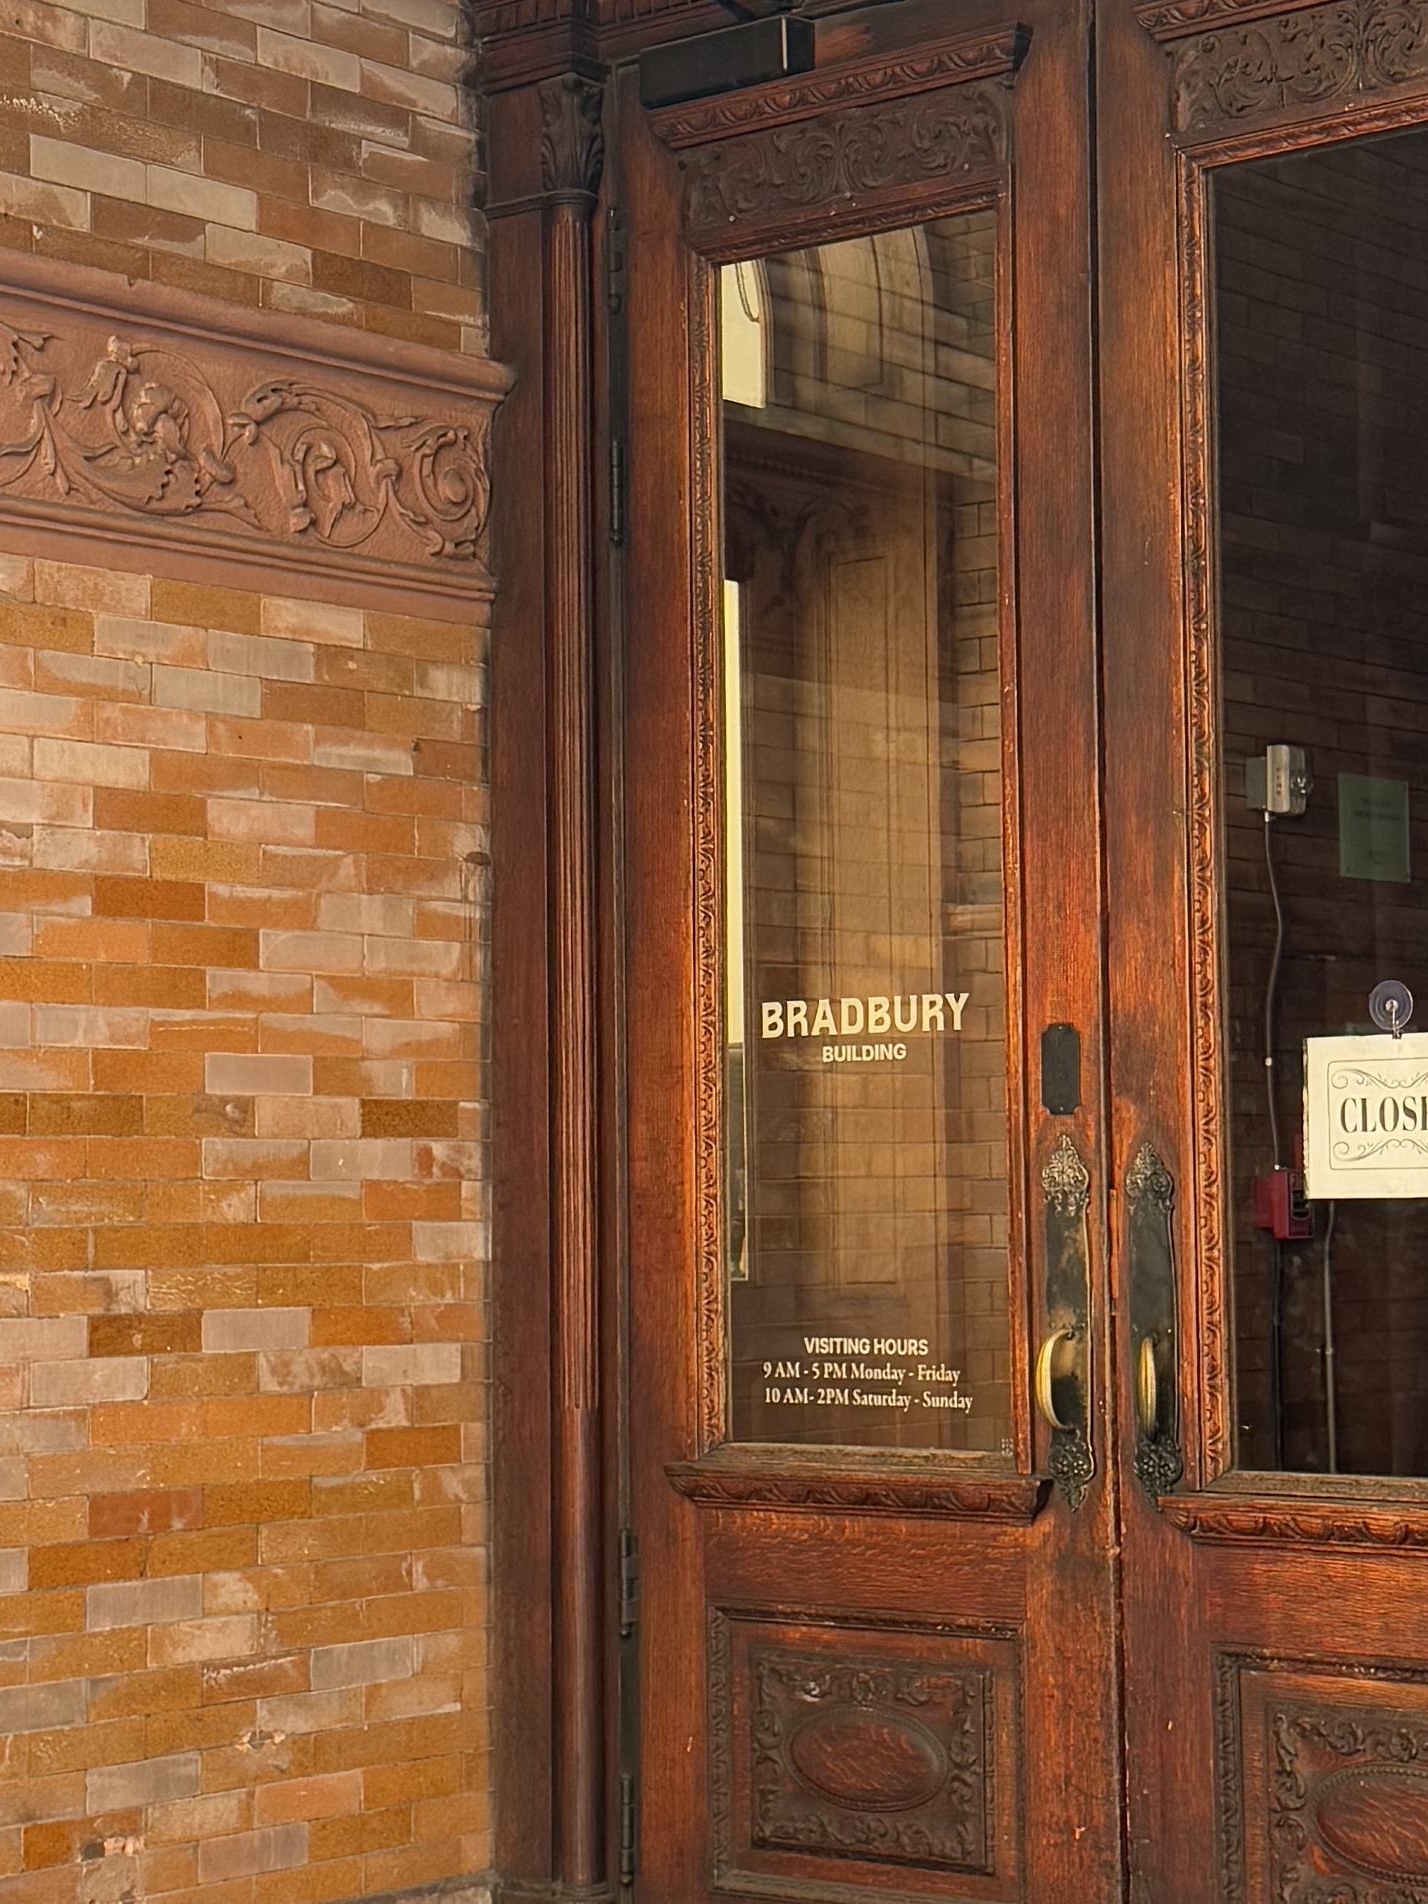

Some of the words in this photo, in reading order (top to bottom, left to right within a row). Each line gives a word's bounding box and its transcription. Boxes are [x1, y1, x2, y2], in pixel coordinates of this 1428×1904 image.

[761, 992, 970, 1039] BRADBURY
[822, 1043, 908, 1063] BUILDING
[803, 1337, 871, 1355] VISITING
[873, 1338, 929, 1356] HOURS
[762, 1361, 773, 1379] 9
[774, 1361, 801, 1378] AM
[811, 1362, 821, 1380] 5
[823, 1362, 847, 1379] PM
[850, 1362, 907, 1386] Monday
[917, 1363, 961, 1387] Friday
[765, 1387, 781, 1404] 10
[816, 1388, 850, 1405] 2PM
[852, 1388, 912, 1413] Saturday
[922, 1390, 974, 1414] Sunday
